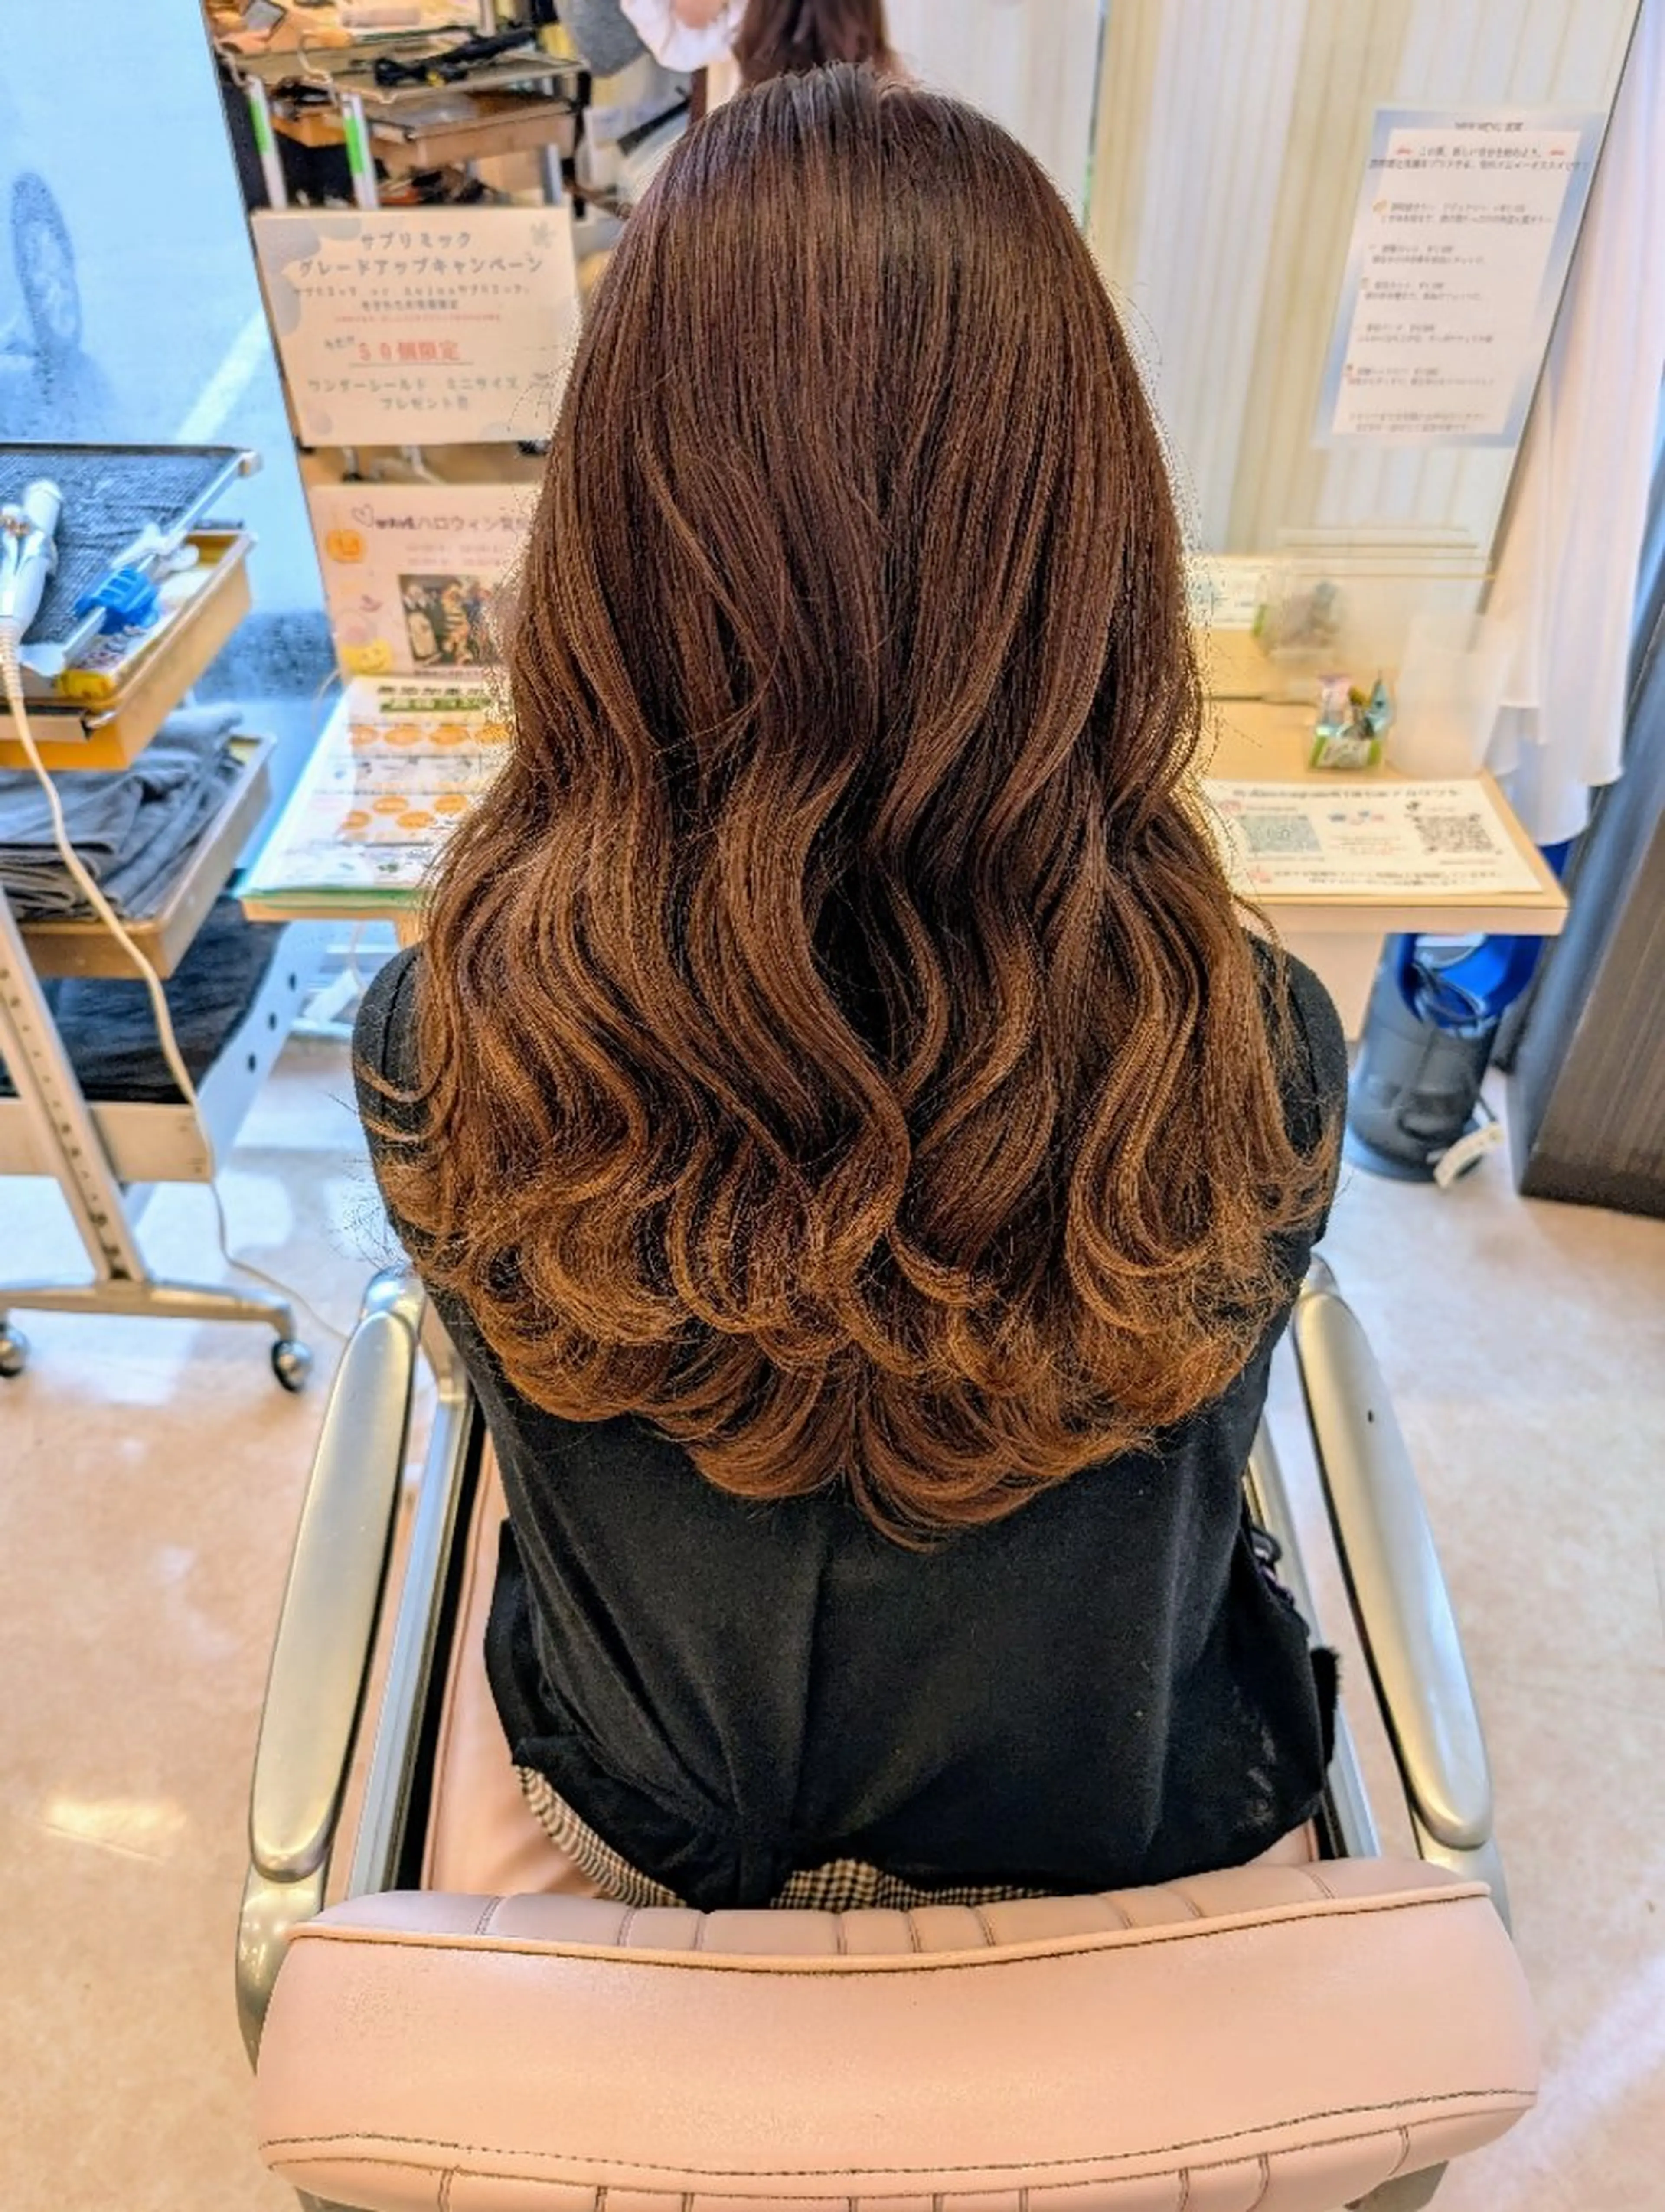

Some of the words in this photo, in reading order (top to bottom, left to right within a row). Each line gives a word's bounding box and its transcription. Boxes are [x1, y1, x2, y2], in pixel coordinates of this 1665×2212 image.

[361, 232, 471, 251] サブリミック
[299, 253, 542, 276] グレードアップキャンペーン
